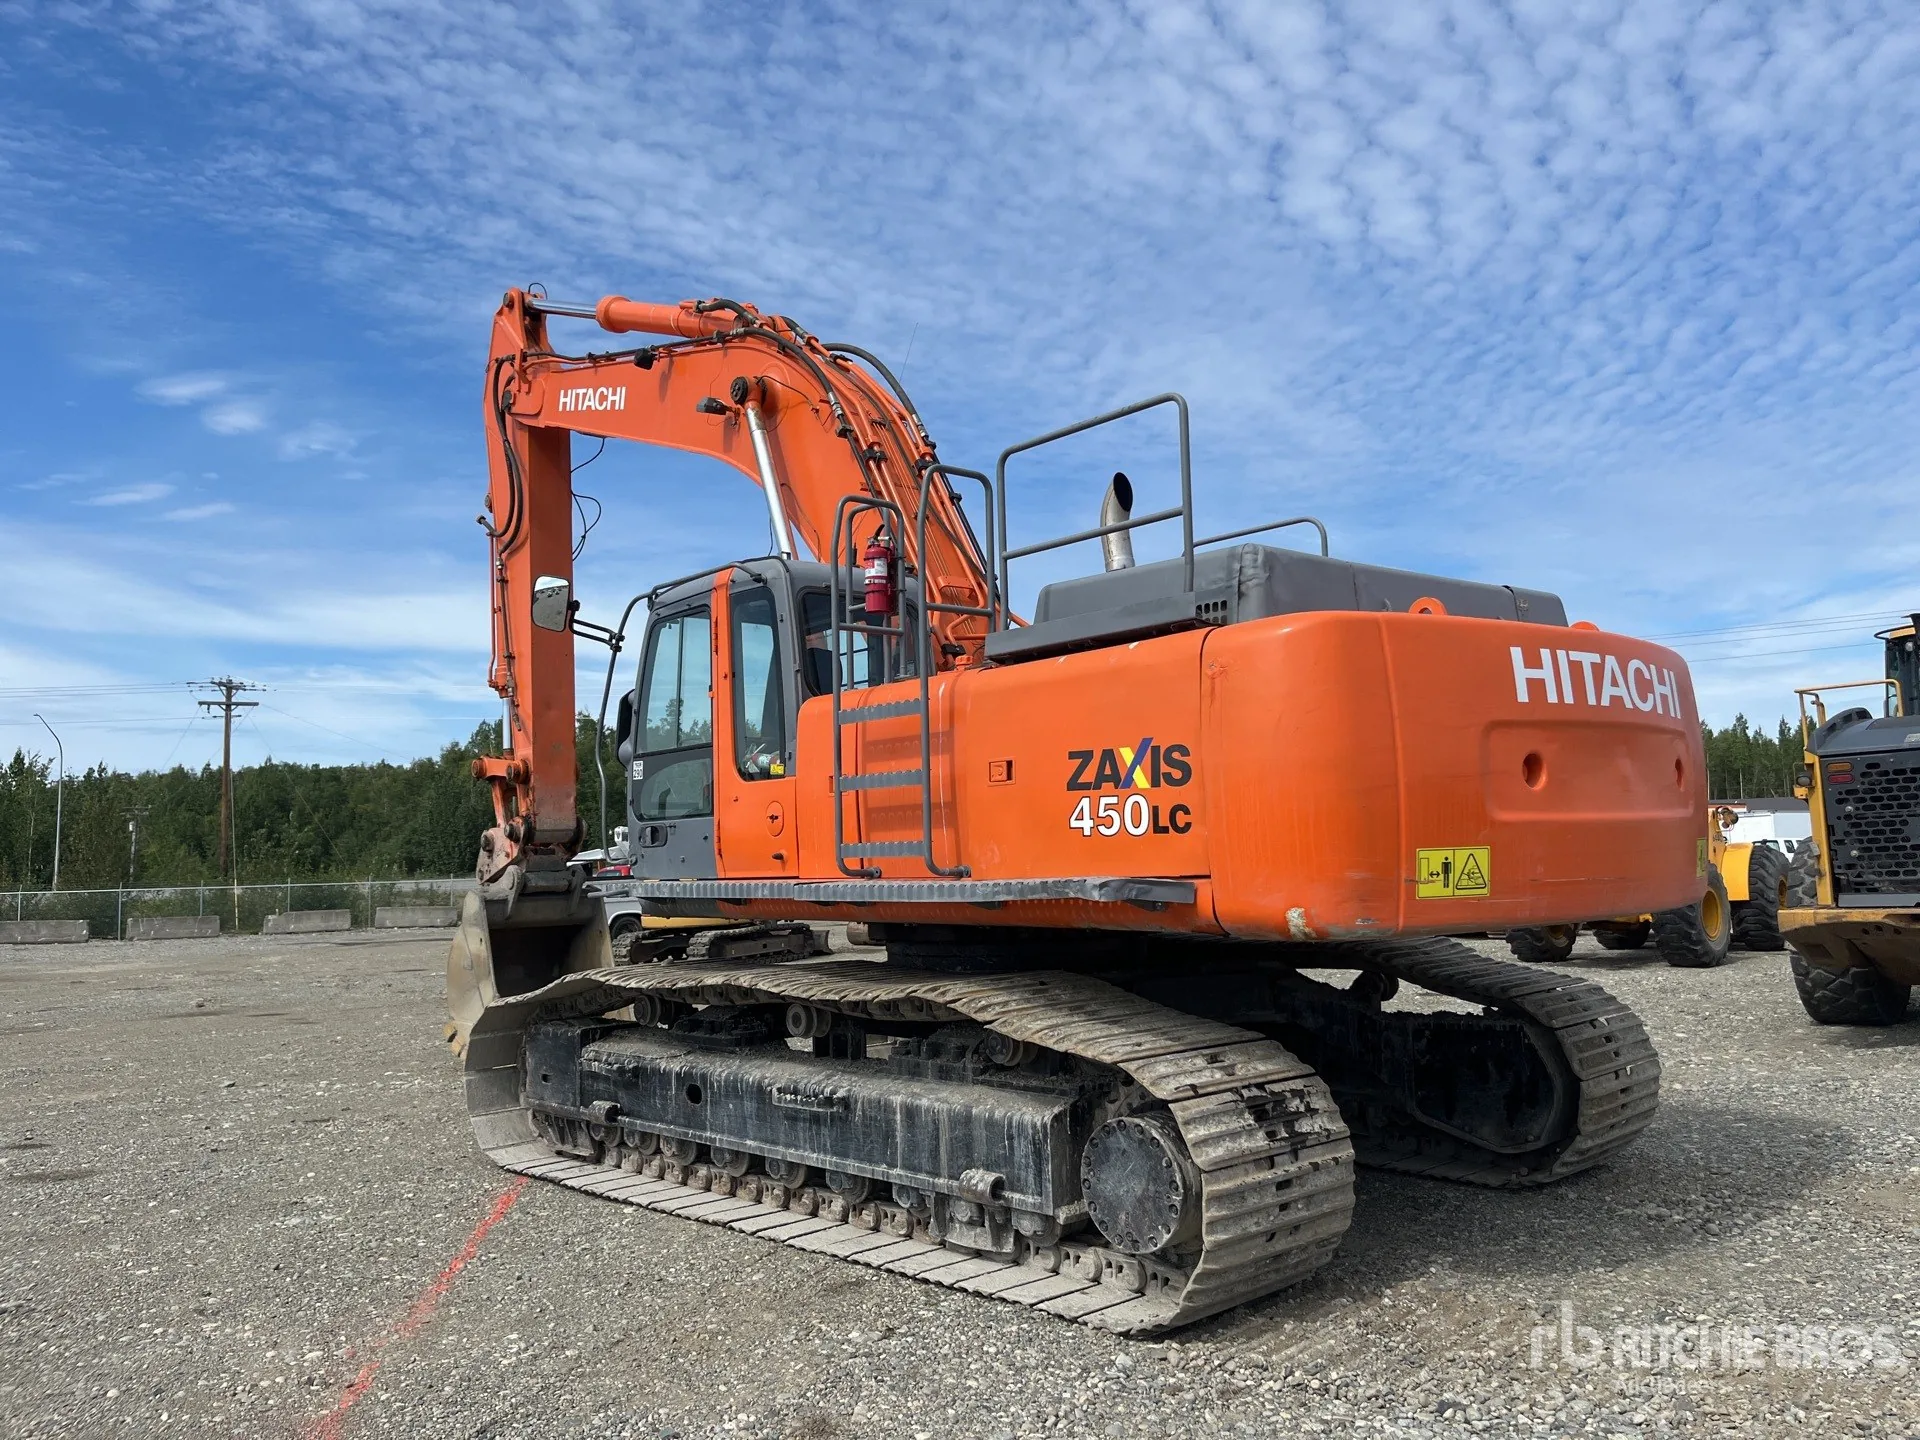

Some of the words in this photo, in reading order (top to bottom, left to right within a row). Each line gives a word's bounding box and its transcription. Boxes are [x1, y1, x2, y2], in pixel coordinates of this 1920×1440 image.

[559, 387, 626, 411] HITACHI
[1509, 646, 1681, 719] HITACHI
[1066, 737, 1192, 791] ZAXIS
